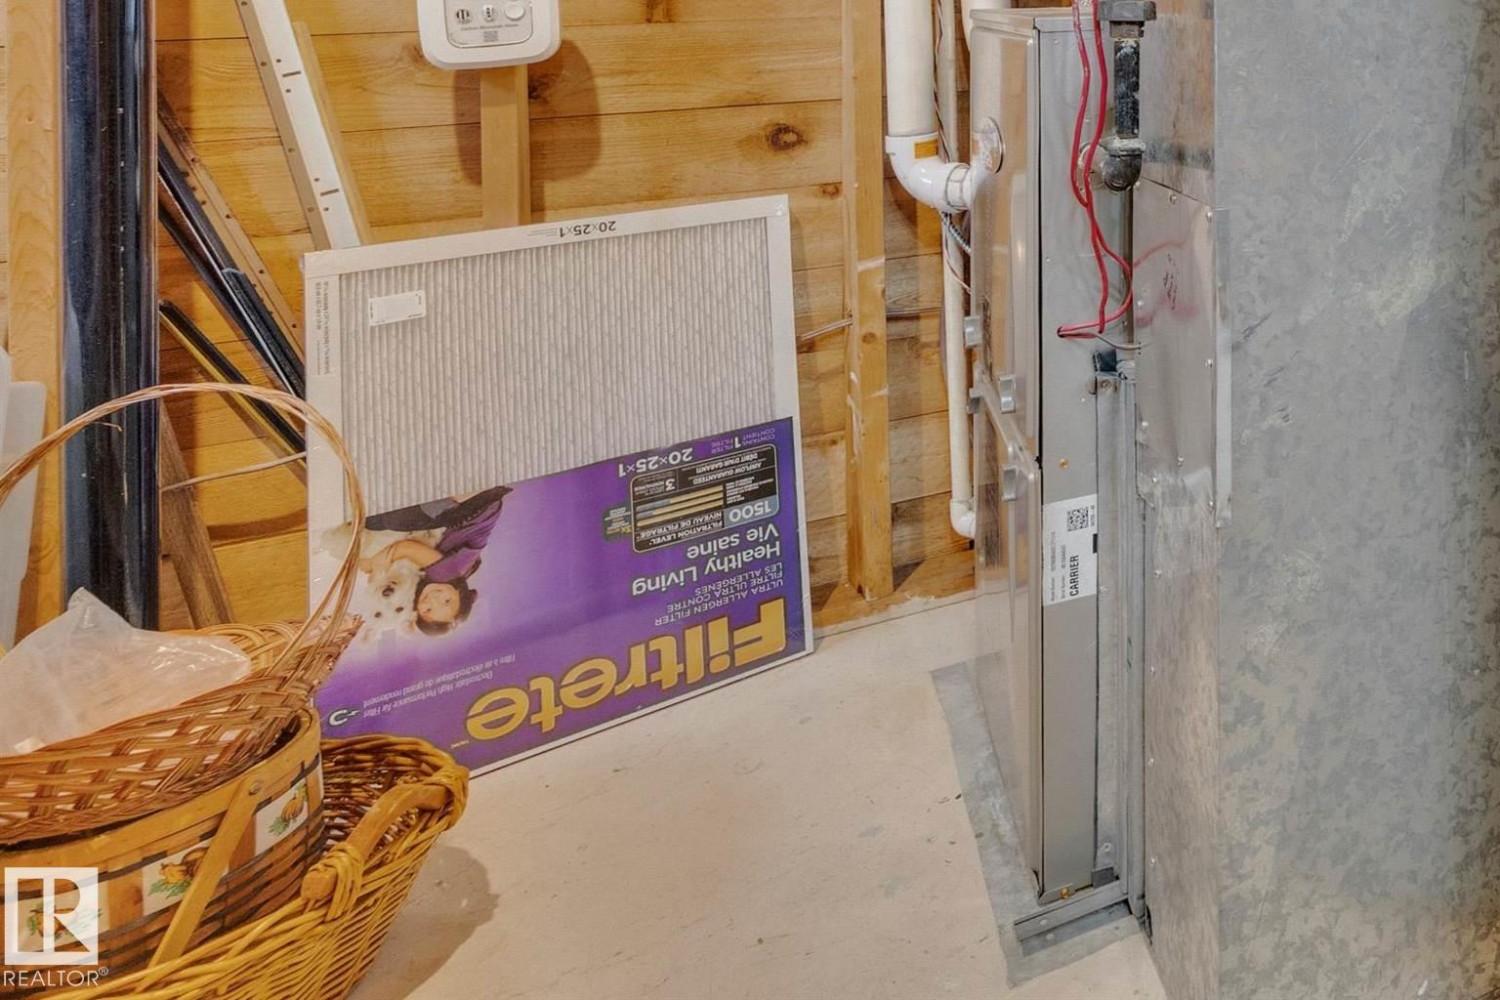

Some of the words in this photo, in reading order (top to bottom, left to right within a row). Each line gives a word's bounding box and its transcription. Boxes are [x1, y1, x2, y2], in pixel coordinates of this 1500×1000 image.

[734, 437, 741, 448] 1
[695, 461, 725, 473] GARANTI
[735, 462, 762, 475] AIRFLOW
[692, 470, 734, 485] GUARANTEED
[693, 512, 722, 525] NIVEAU
[728, 500, 772, 522] 1500
[677, 520, 723, 541] FILTRATION
[681, 519, 692, 527] DE
[747, 523, 780, 544] Vie
[686, 534, 740, 560] saine
[704, 540, 781, 577] Healthy
[764, 561, 782, 574] LES
[632, 566, 698, 597] Living
[749, 570, 783, 586] FILTRE
[1070, 555, 1079, 596] CARRIER
[714, 580, 748, 598] ULTRA
[751, 579, 784, 594] ULTRA
[666, 592, 711, 613] CONTRE
[693, 590, 748, 614] ALLERGEN
[654, 607, 691, 626] FILTER
[465, 597, 787, 741] Filtrete
